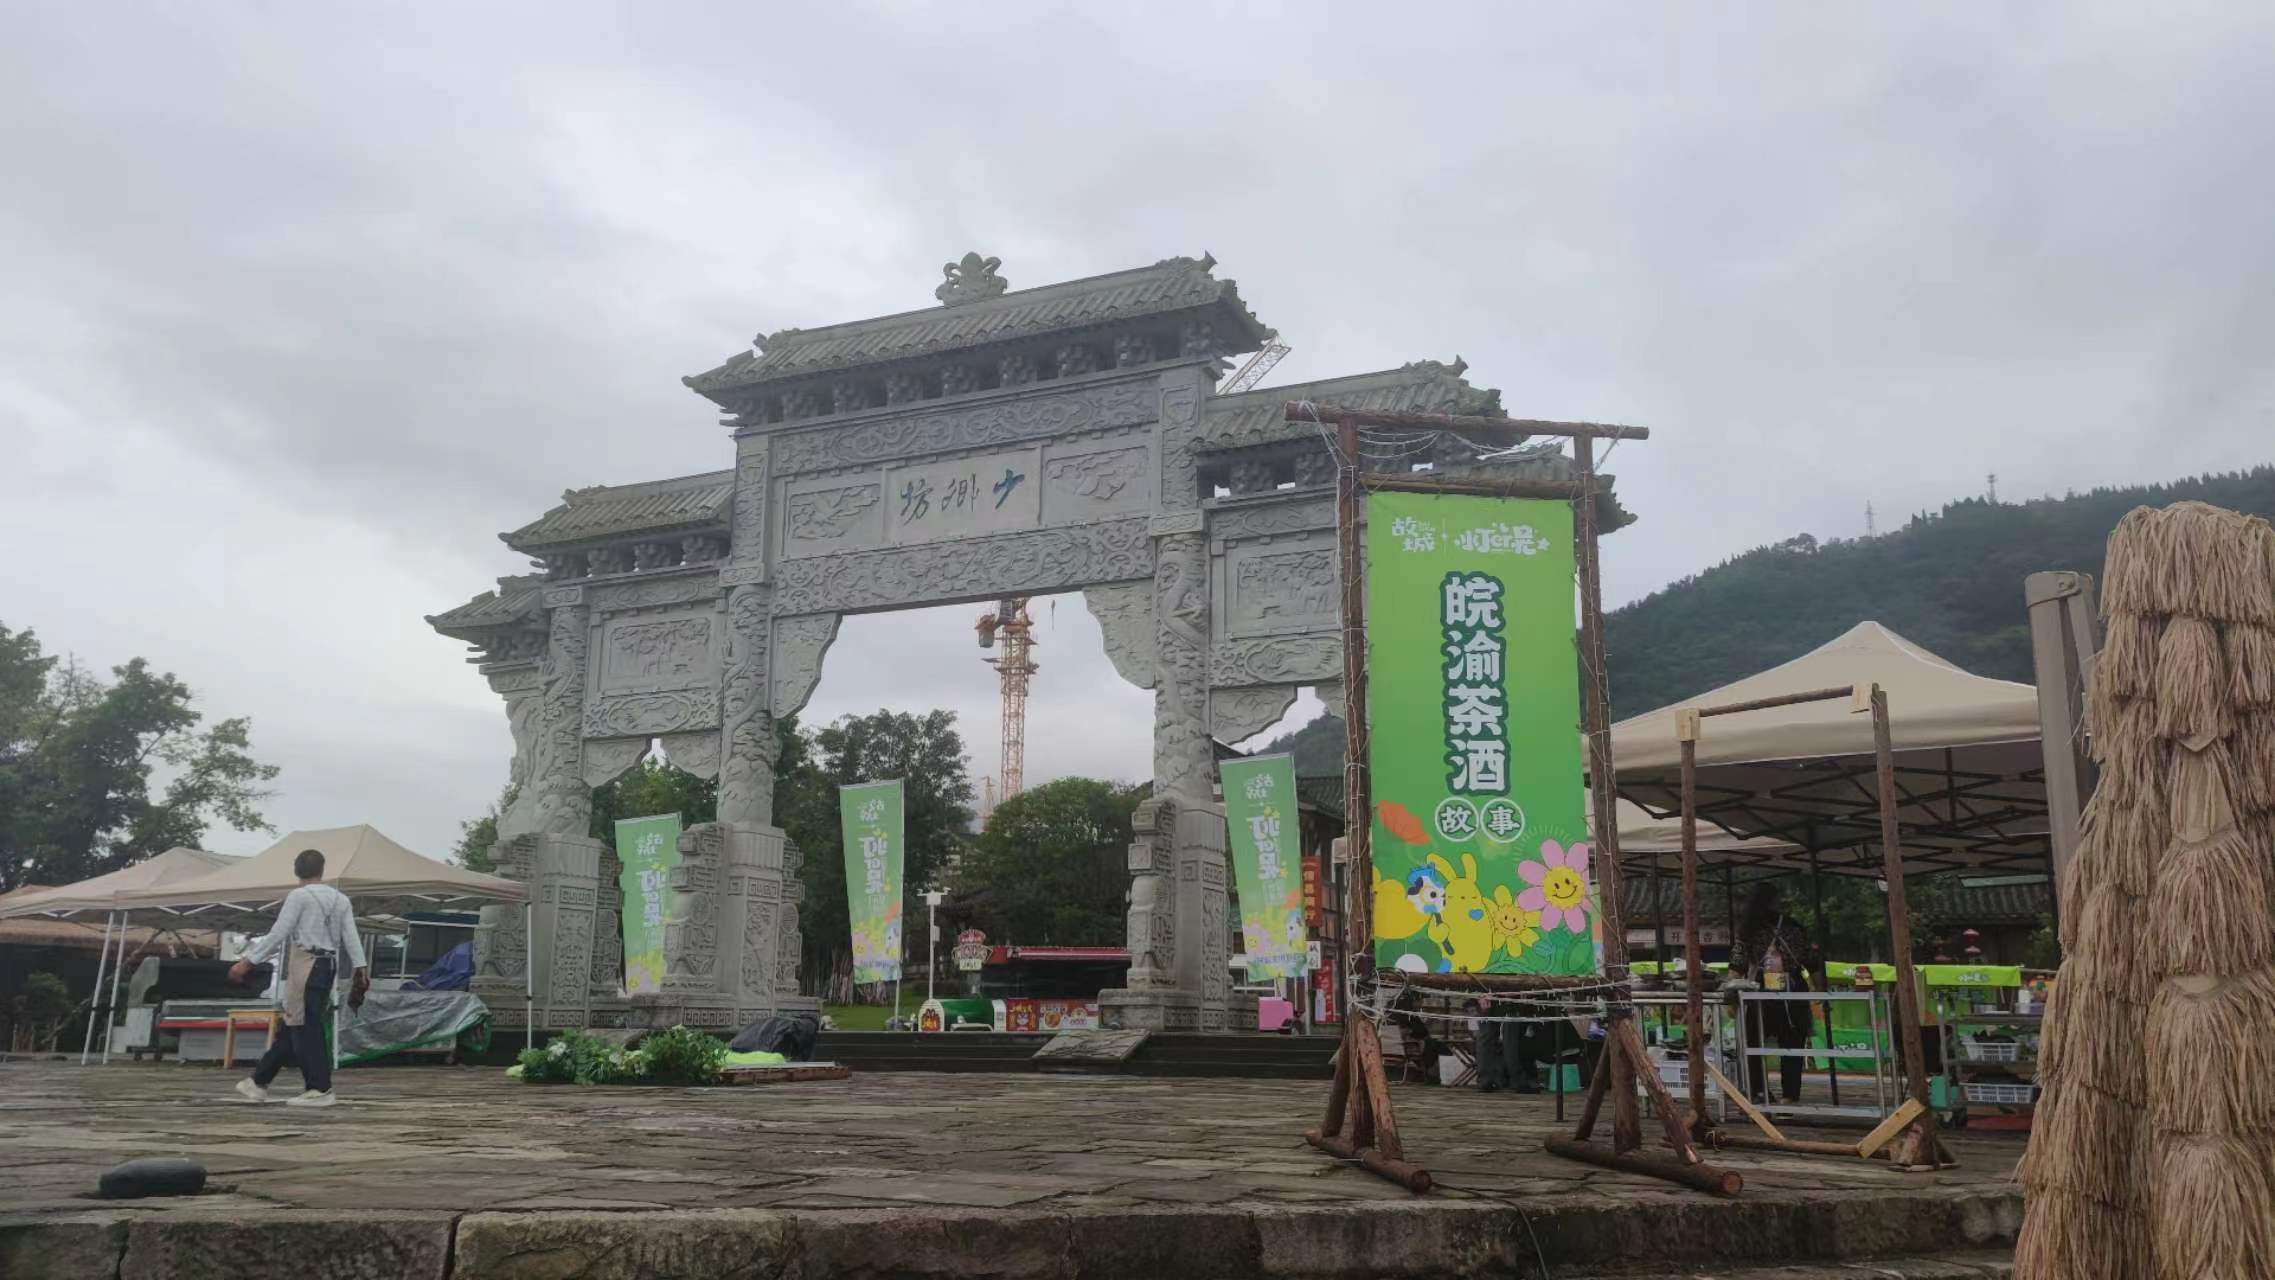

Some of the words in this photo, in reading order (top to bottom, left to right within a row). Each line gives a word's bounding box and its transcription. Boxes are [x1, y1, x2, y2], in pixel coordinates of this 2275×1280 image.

[1444, 575, 1507, 792] 皖渝茶酒
[1439, 805, 1522, 836] 故事
